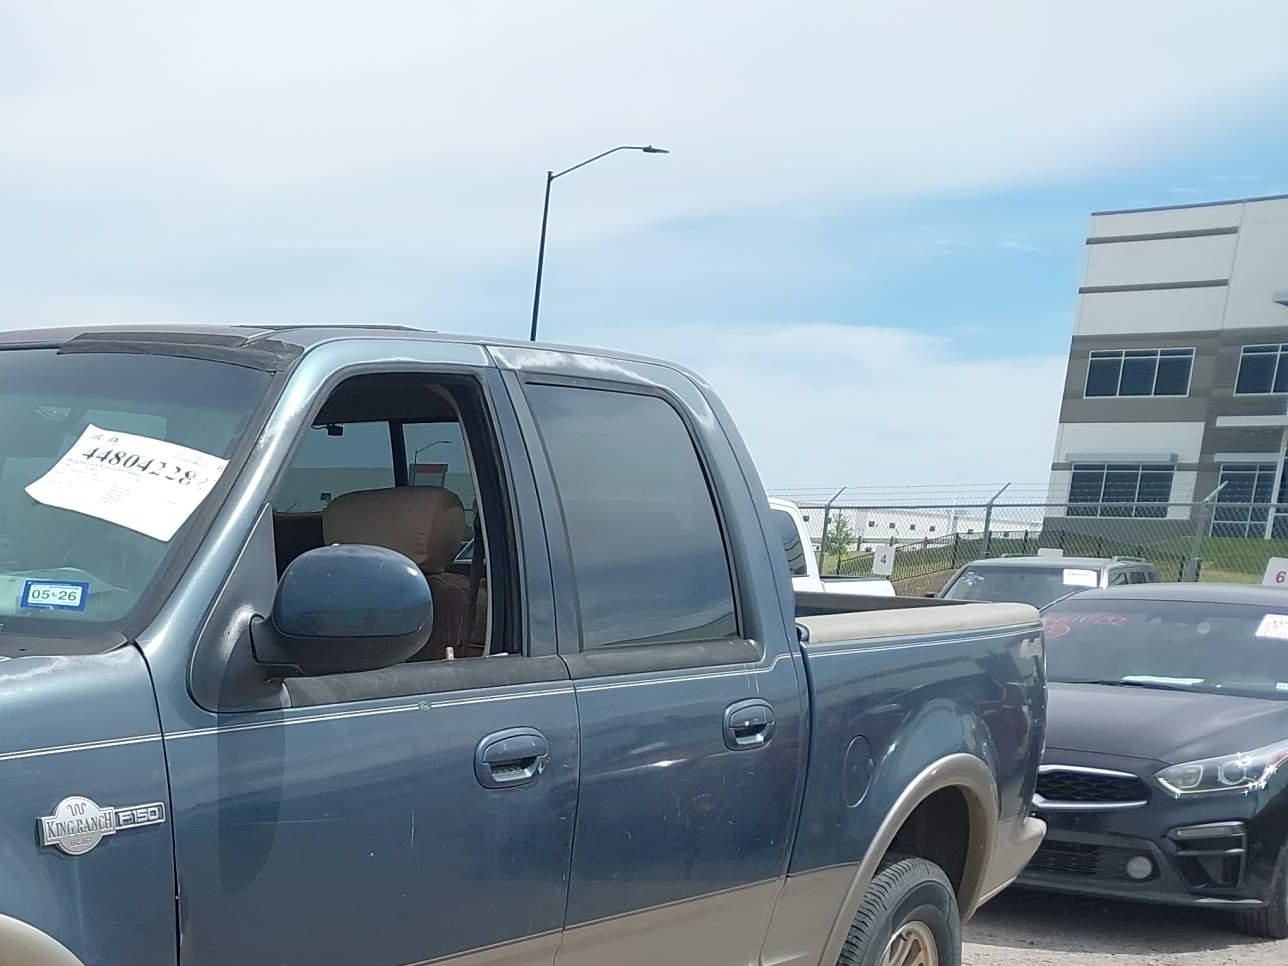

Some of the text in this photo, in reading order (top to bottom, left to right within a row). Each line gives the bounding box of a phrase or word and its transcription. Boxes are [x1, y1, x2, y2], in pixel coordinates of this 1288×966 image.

[81, 446, 197, 486] 44804228
[880, 553, 887, 565] 4
[1275, 570, 1287, 584] 6
[78, 812, 112, 834] RANCH
